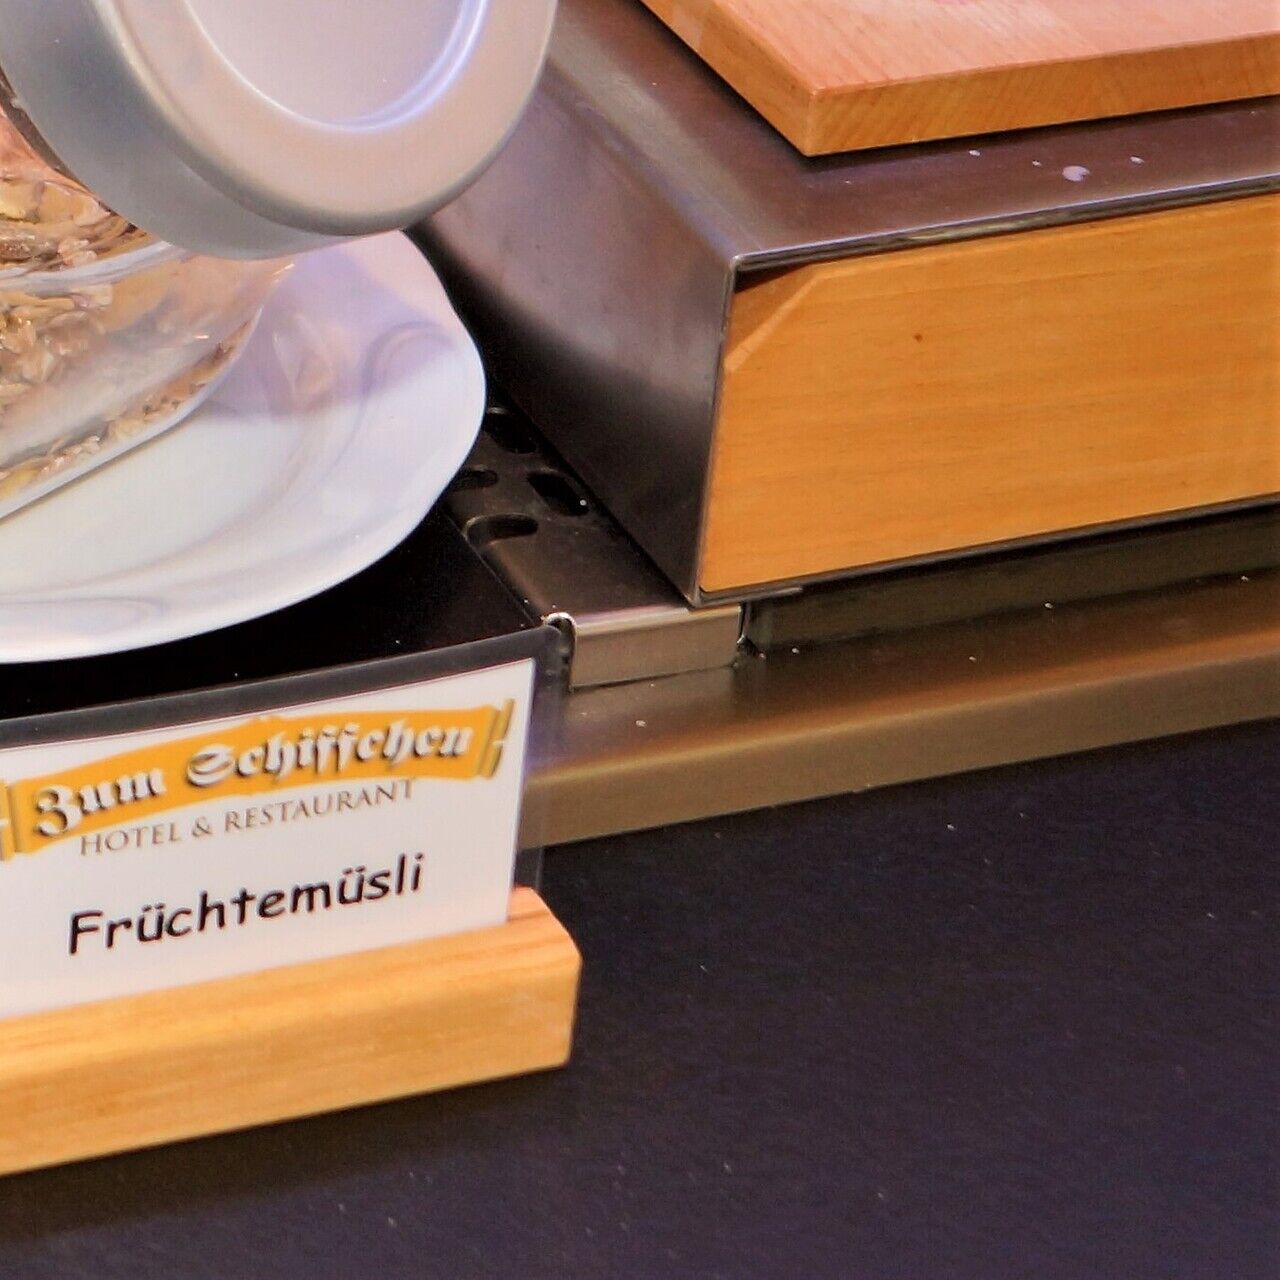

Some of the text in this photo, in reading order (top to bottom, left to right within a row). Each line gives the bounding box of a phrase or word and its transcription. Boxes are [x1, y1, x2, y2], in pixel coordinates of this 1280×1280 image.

[31, 719, 474, 838] Zum Schiffchen
[79, 779, 416, 856] HOTEL & RESTAURANT
[67, 852, 425, 956] Früchtemüsli
